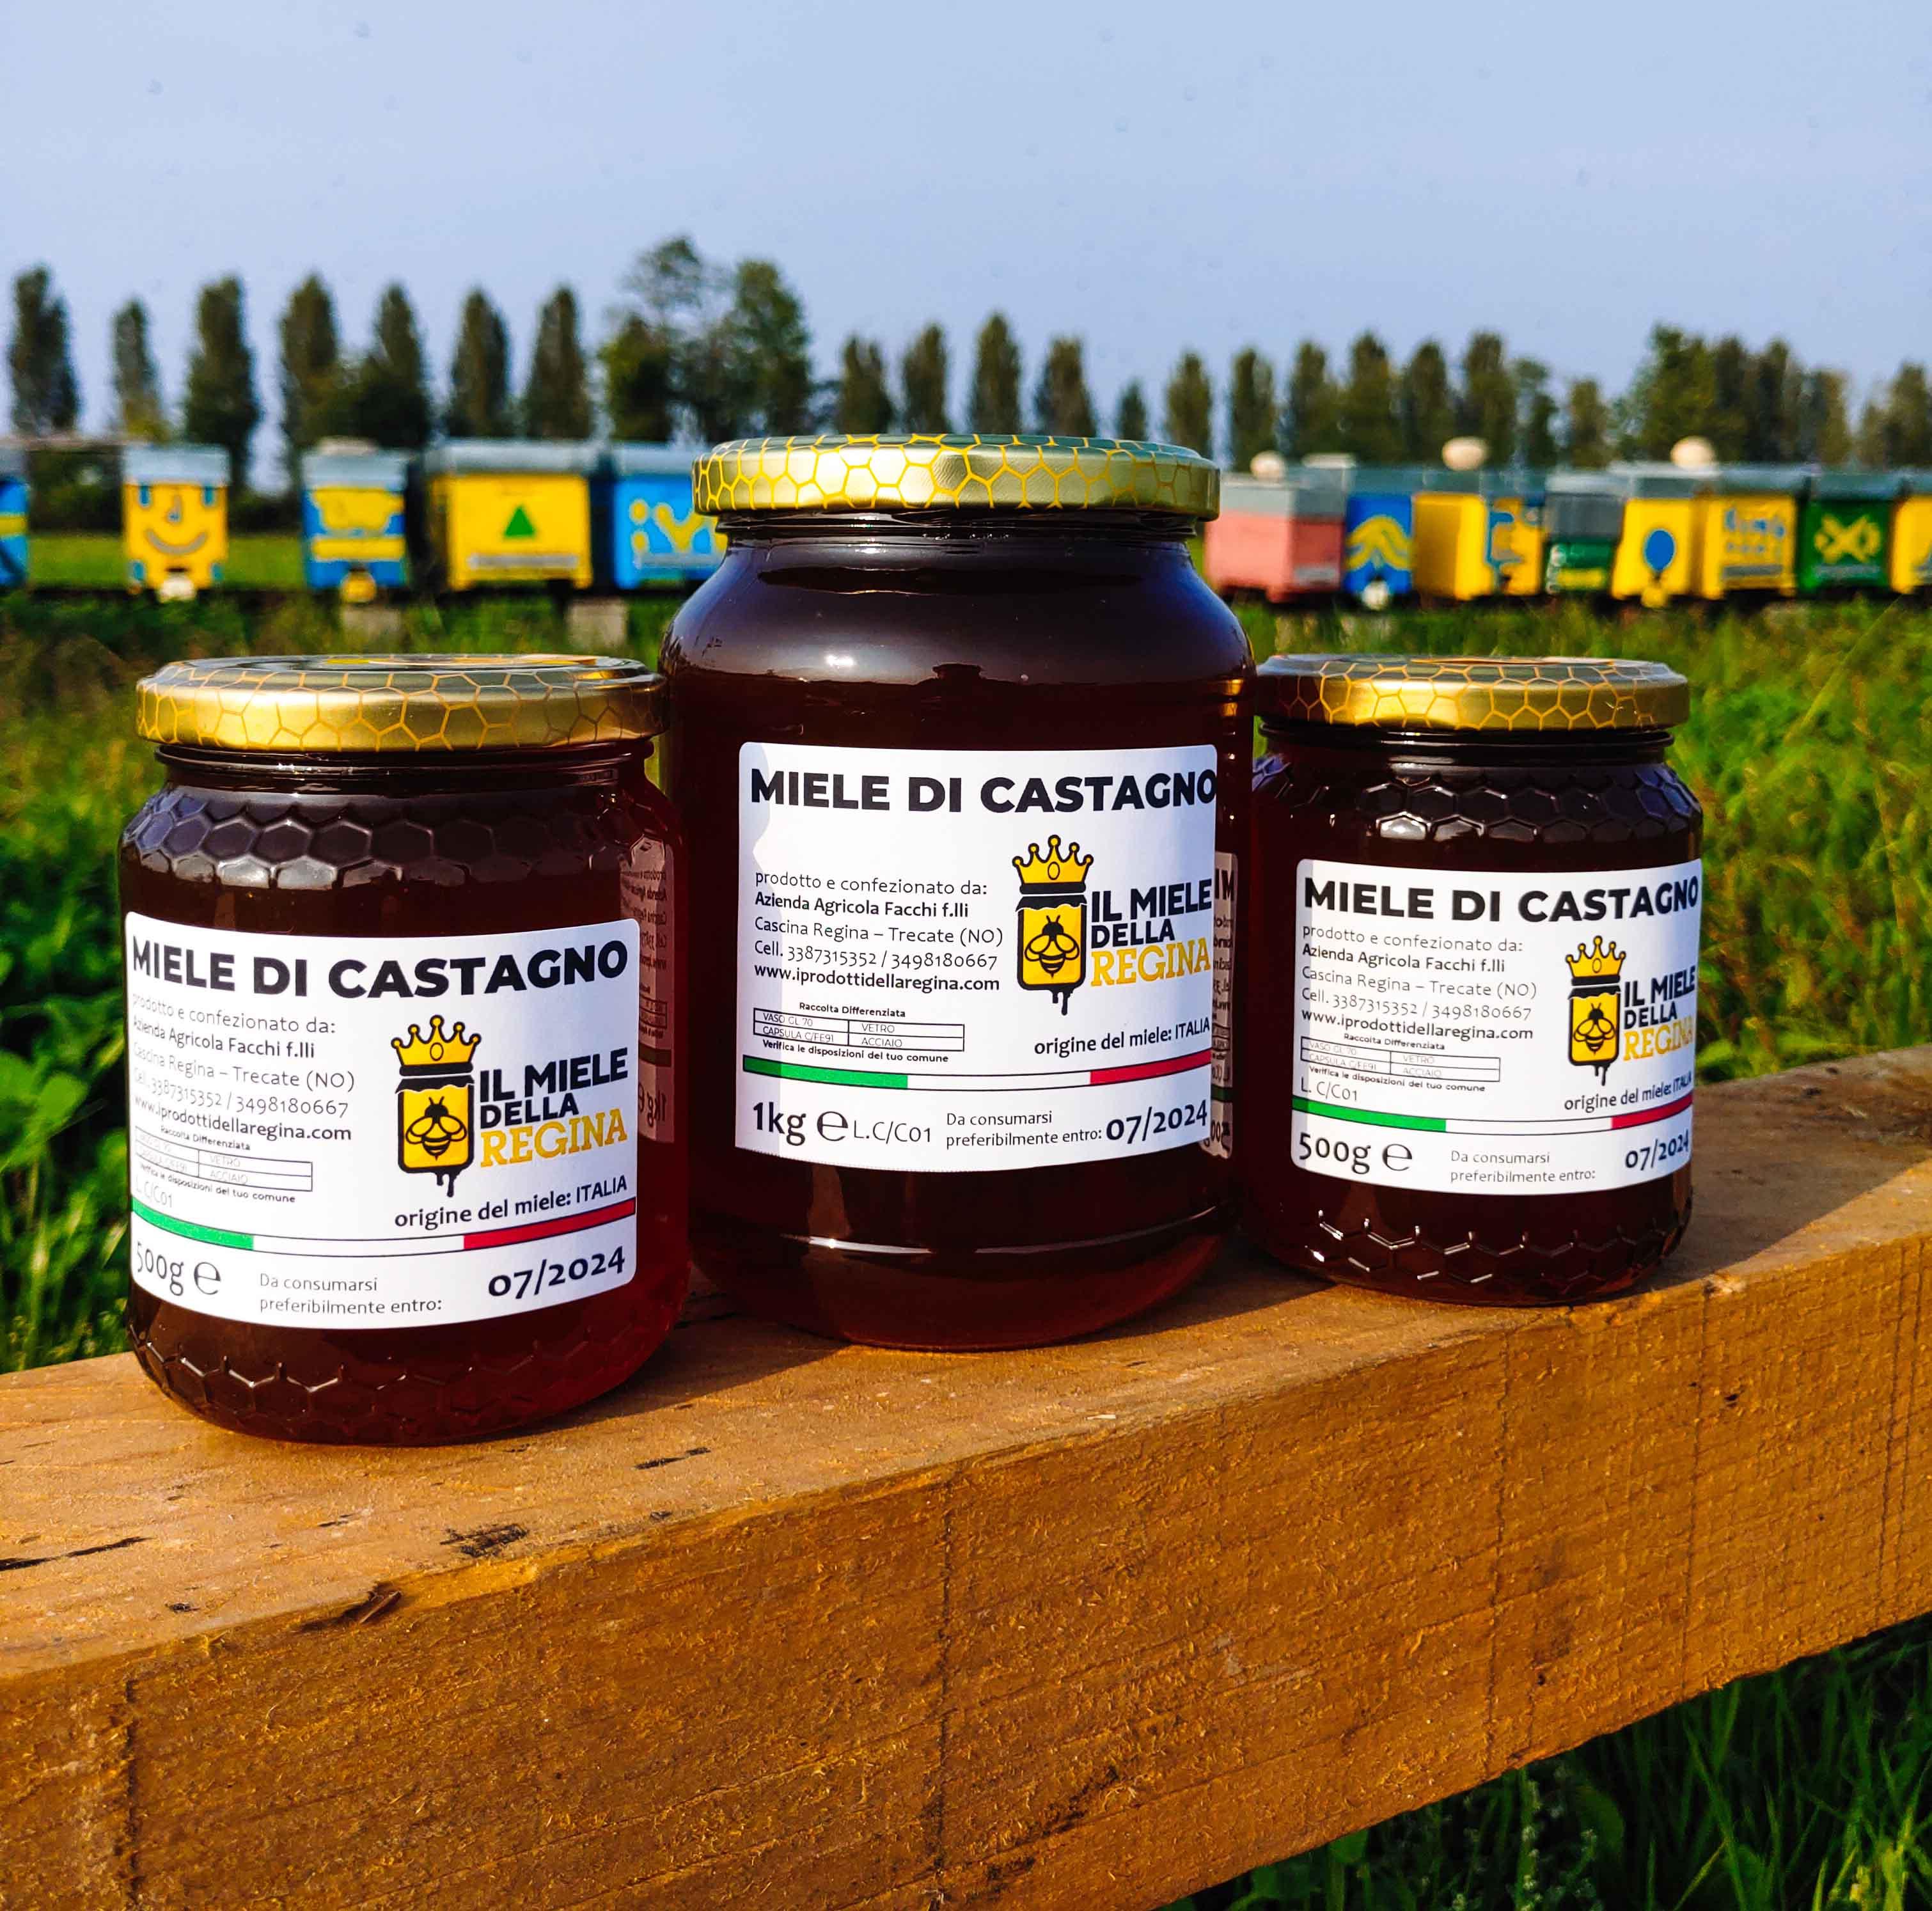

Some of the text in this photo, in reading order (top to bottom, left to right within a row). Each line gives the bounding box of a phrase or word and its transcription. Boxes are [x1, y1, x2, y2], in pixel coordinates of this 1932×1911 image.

[751, 769, 1216, 813] MIELE DI CASTAGNO
[756, 872, 987, 895] prodotto e confezionato da:
[755, 892, 968, 917] Azienda Agricola Facchi f.lli
[1092, 891, 1122, 922] IL
[1131, 879, 1212, 919] MIELE
[1305, 876, 1698, 922] MIELE DI CASTAGNO
[755, 917, 1003, 947] Cascina Regina Trecate (NO)
[1091, 918, 1175, 948] DELLA
[1303, 925, 1523, 952] prodotto e confezionato da:
[134, 935, 627, 998] MIELE DI CASTAGNO
[755, 941, 783, 957] Cell.
[788, 947, 876, 967] 3387315352
[891, 953, 997, 970] 3498180667
[1091, 937, 1211, 986] REGINA
[1302, 943, 1505, 972] Azienda Agricola Facchi f.lli
[755, 964, 1000, 994] www.iprodottidellaregina.com
[1302, 966, 1537, 1000] Cascina Regina Trecate (NO)
[1624, 965, 1695, 1007] IL MIELE
[763, 1012, 785, 1023] VASO
[799, 1002, 906, 1018] Raccolta Differenziata
[1301, 987, 1330, 1003] Cell.
[1333, 995, 1418, 1016] 3387315352
[1432, 1005, 1531, 1021] 3498180667
[1624, 1001, 1677, 1030] DELLA
[178, 1009, 184, 1019] e
[190, 1009, 298, 1032] confezionato
[306, 1018, 335, 1034] da:
[861, 1023, 895, 1034] VETRO
[1301, 1009, 1534, 1041] www.iprodottidellaregina.com
[169, 1028, 223, 1051] Agricola
[230, 1038, 280, 1056] Facchi
[287, 1042, 314, 1058] f.lli
[763, 1039, 794, 1052] Verifica
[808, 1046, 864, 1060] disposizioni
[868, 1051, 883, 1060] del
[886, 1052, 903, 1062] tuo
[907, 1054, 948, 1063] comune
[861, 1037, 902, 1048] ACCIAIO
[1034, 1037, 1096, 1058] origine
[1101, 1032, 1124, 1050] del
[1129, 1026, 1172, 1047] miele:
[1175, 1017, 1210, 1039] ITALIA
[1344, 1033, 1445, 1050] Raccolta Differenziata
[169, 1056, 214, 1078] Regina
[233, 1066, 299, 1086] Trecate
[306, 1071, 354, 1092] (NO)
[480, 1048, 627, 1102] IL MIELE
[1310, 1065, 1339, 1078] Verifica
[1353, 1073, 1405, 1087] disposizioni
[1410, 1079, 1423, 1088] del
[1446, 1083, 1485, 1092] comune
[1317, 1081, 1358, 1101] C/C01
[1564, 1093, 1617, 1113] origine
[1621, 1087, 1638, 1105] del
[1642, 1081, 1671, 1101] miele:
[134, 1095, 352, 1142] www.iprodottidellaregina.com
[236, 1097, 348, 1118] 3498180667
[480, 1092, 579, 1129] DELLA
[947, 1111, 1052, 1126] Da consumarsi
[480, 1108, 627, 1167] REGINA
[753, 1101, 806, 1146] 1kg
[946, 1132, 1058, 1149] preferibilmente
[1062, 1129, 1102, 1143] entro:
[1106, 1099, 1207, 1144] 07/2024
[193, 1135, 250, 1151] Differenziata
[1299, 1132, 1371, 1175] 500g
[1451, 1151, 1550, 1164] Da consumarsi
[1625, 1129, 1689, 1171] 07/2024
[1451, 1168, 1596, 1184] preferibilmente entro:
[216, 1186, 230, 1195] del
[233, 1190, 248, 1198] tuo
[253, 1193, 295, 1202] comune
[395, 1176, 627, 1230] origine del miele: ITALIA
[136, 1241, 184, 1296] 500g
[260, 1273, 377, 1292] Da consumarsi
[489, 1246, 625, 1299] 07/2024
[260, 1298, 442, 1315] preferibilmente entro:
